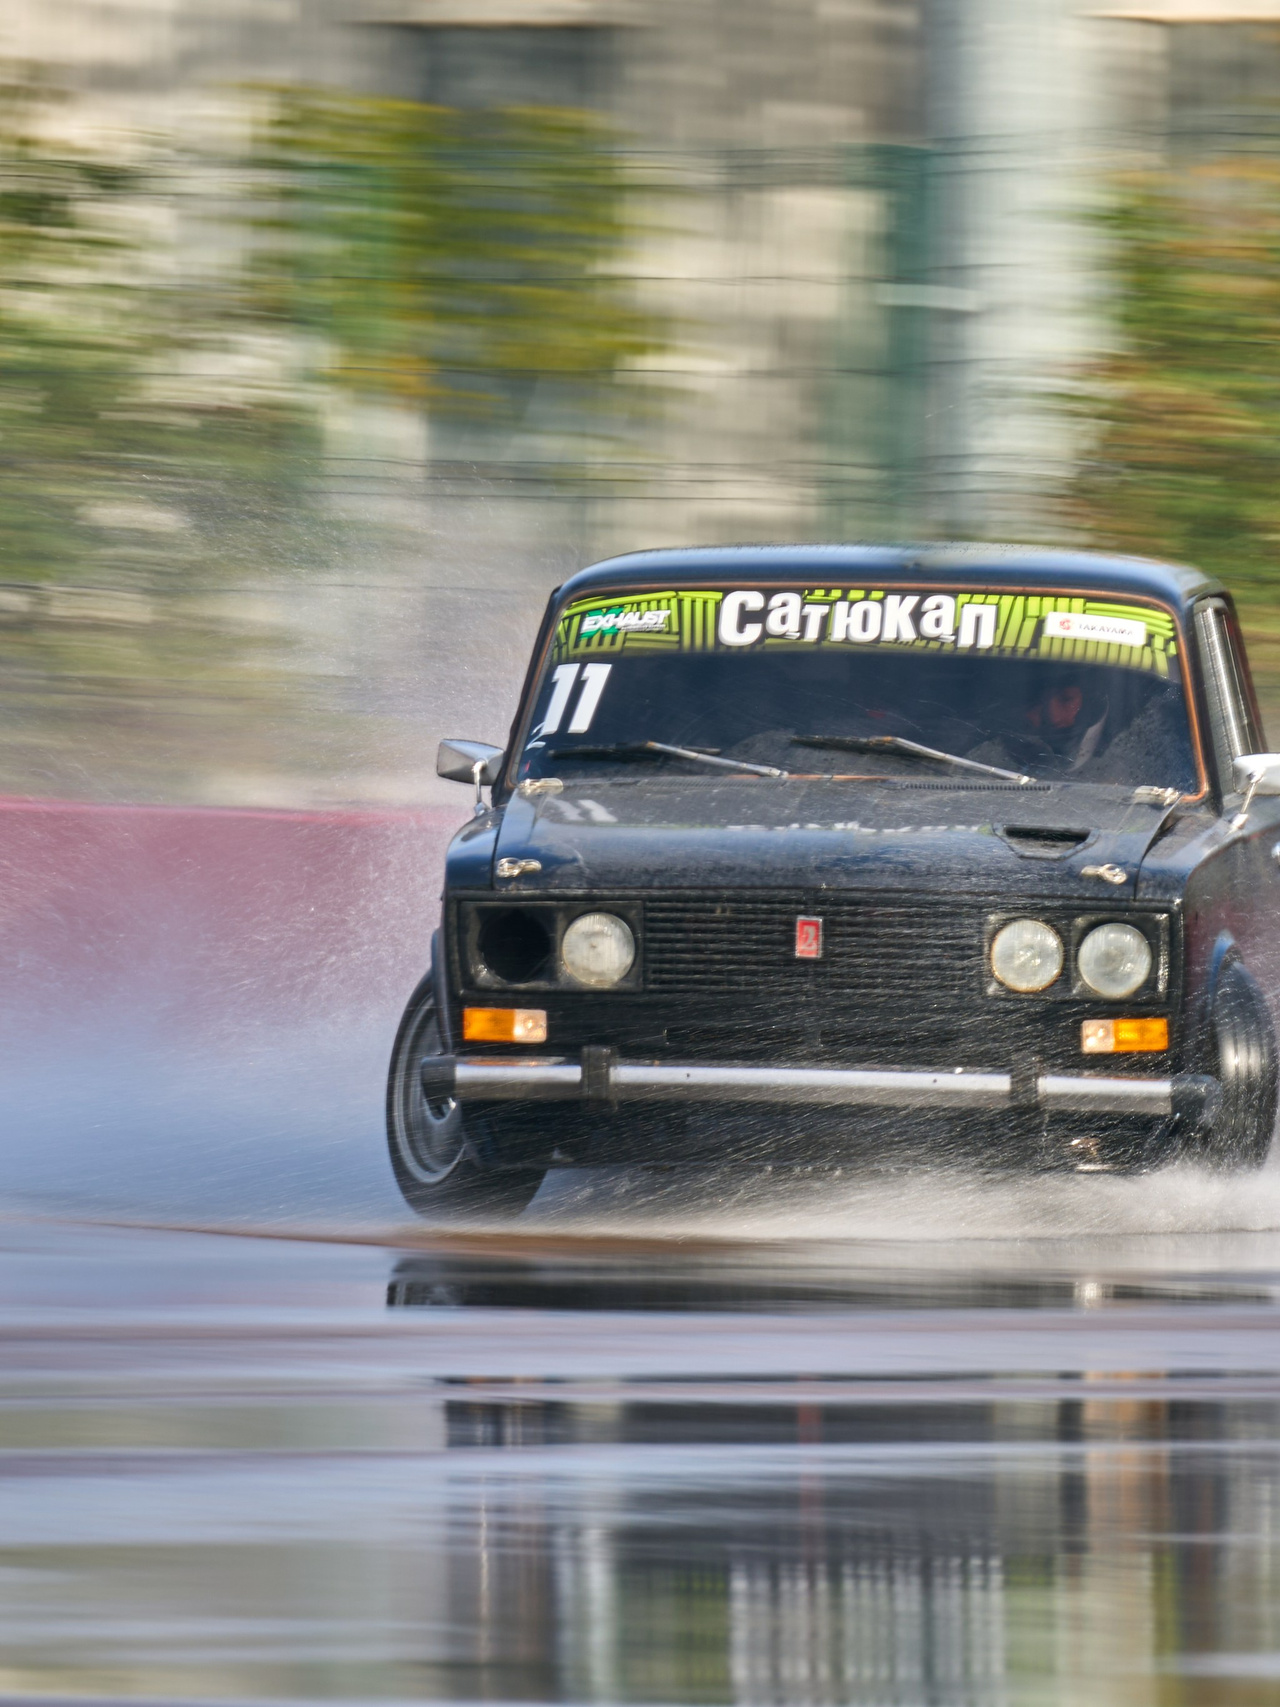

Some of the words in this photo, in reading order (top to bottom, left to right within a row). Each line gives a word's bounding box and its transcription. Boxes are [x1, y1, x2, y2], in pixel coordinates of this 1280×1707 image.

[580, 610, 671, 634] EXHAUST
[718, 590, 998, 649] Сатюкап
[540, 662, 613, 735] 11
